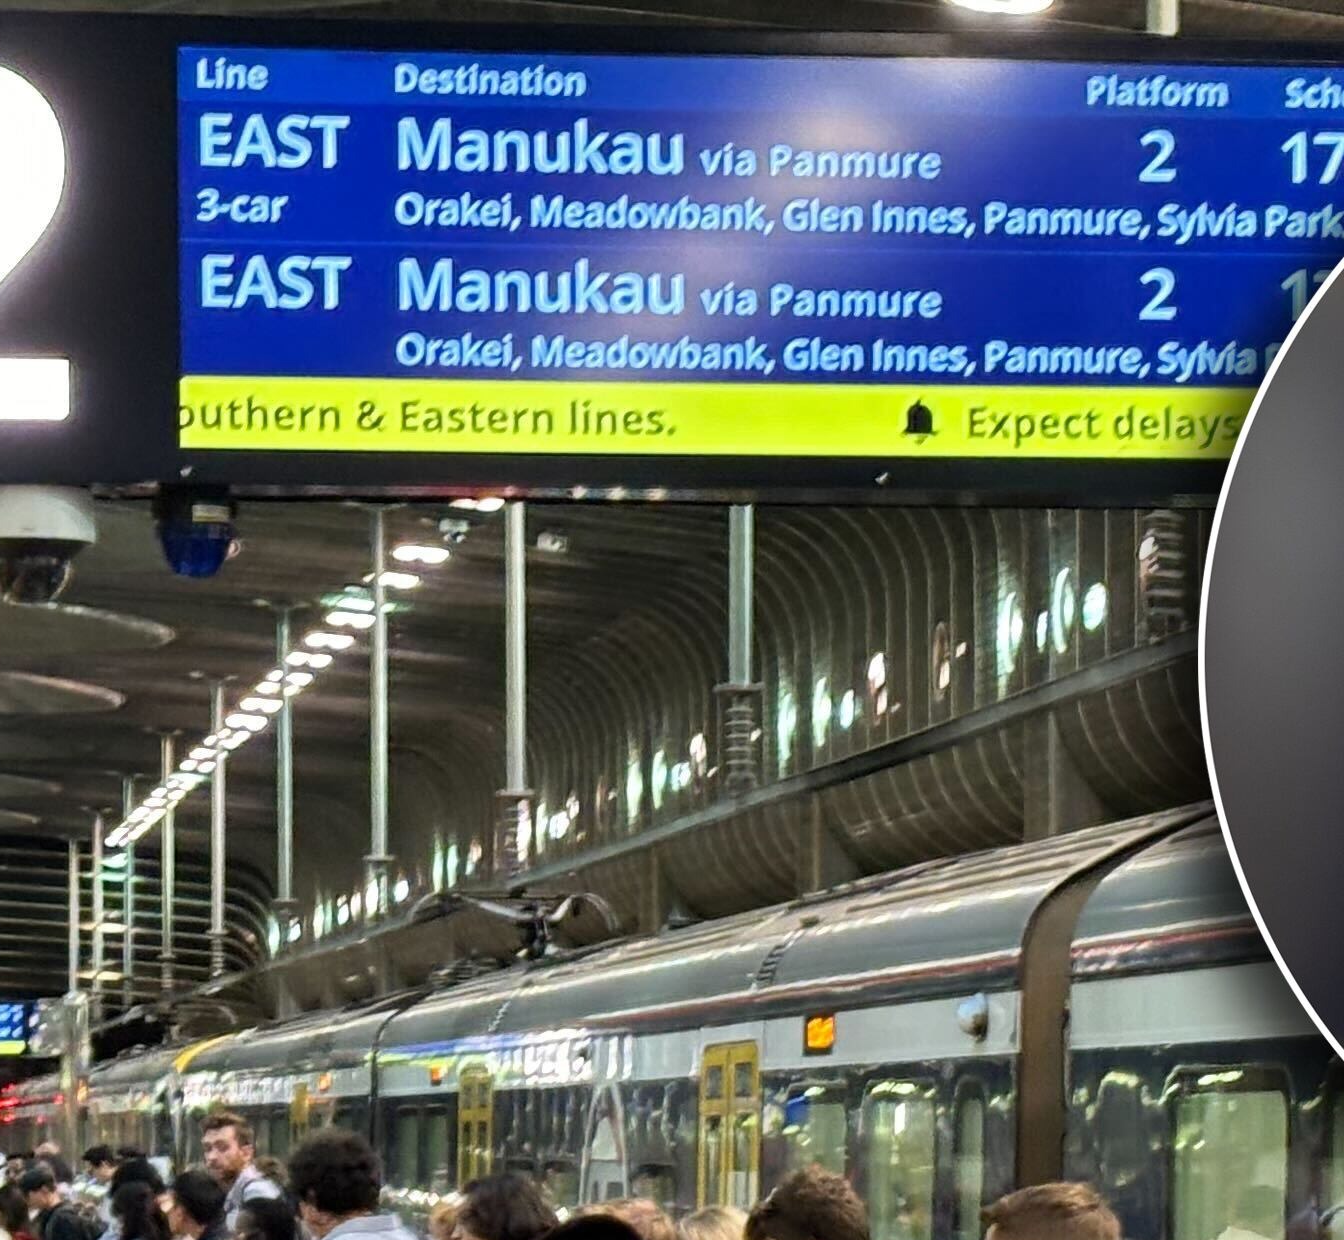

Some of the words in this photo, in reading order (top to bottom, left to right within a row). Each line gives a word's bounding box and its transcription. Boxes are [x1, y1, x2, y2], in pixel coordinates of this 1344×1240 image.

[196, 57, 269, 90] Line
[394, 63, 587, 97] Destination
[1086, 74, 1229, 107] Platform
[199, 112, 351, 169] EAST
[398, 117, 684, 175] Manukau
[700, 142, 757, 177] via
[769, 143, 941, 180] Panmure
[1139, 129, 1177, 183] 2
[196, 187, 290, 223] 3-car
[394, 191, 522, 232] Orakei,
[531, 194, 775, 236] Meadowbank,
[783, 198, 863, 233] Glen
[872, 199, 976, 239] Innes,
[984, 201, 1151, 241] Panmure,
[1157, 202, 1257, 245] Sylvia
[201, 254, 352, 310] EAST
[399, 257, 685, 315] Manukau
[701, 281, 757, 317] via
[770, 283, 942, 319] Panmure
[1139, 267, 1177, 321] 2
[395, 332, 523, 372] Orakei,
[531, 335, 776, 375] Meadowbank,
[783, 336, 864, 372] Glen
[872, 338, 977, 377] Innes,
[984, 340, 1151, 379] Panmure,
[1157, 341, 1257, 383] Sylvia
[357, 399, 384, 431] &
[401, 399, 554, 434] Eastern
[570, 400, 676, 436] lines.
[968, 406, 1102, 448] Expect
[1113, 406, 1241, 449] delays
